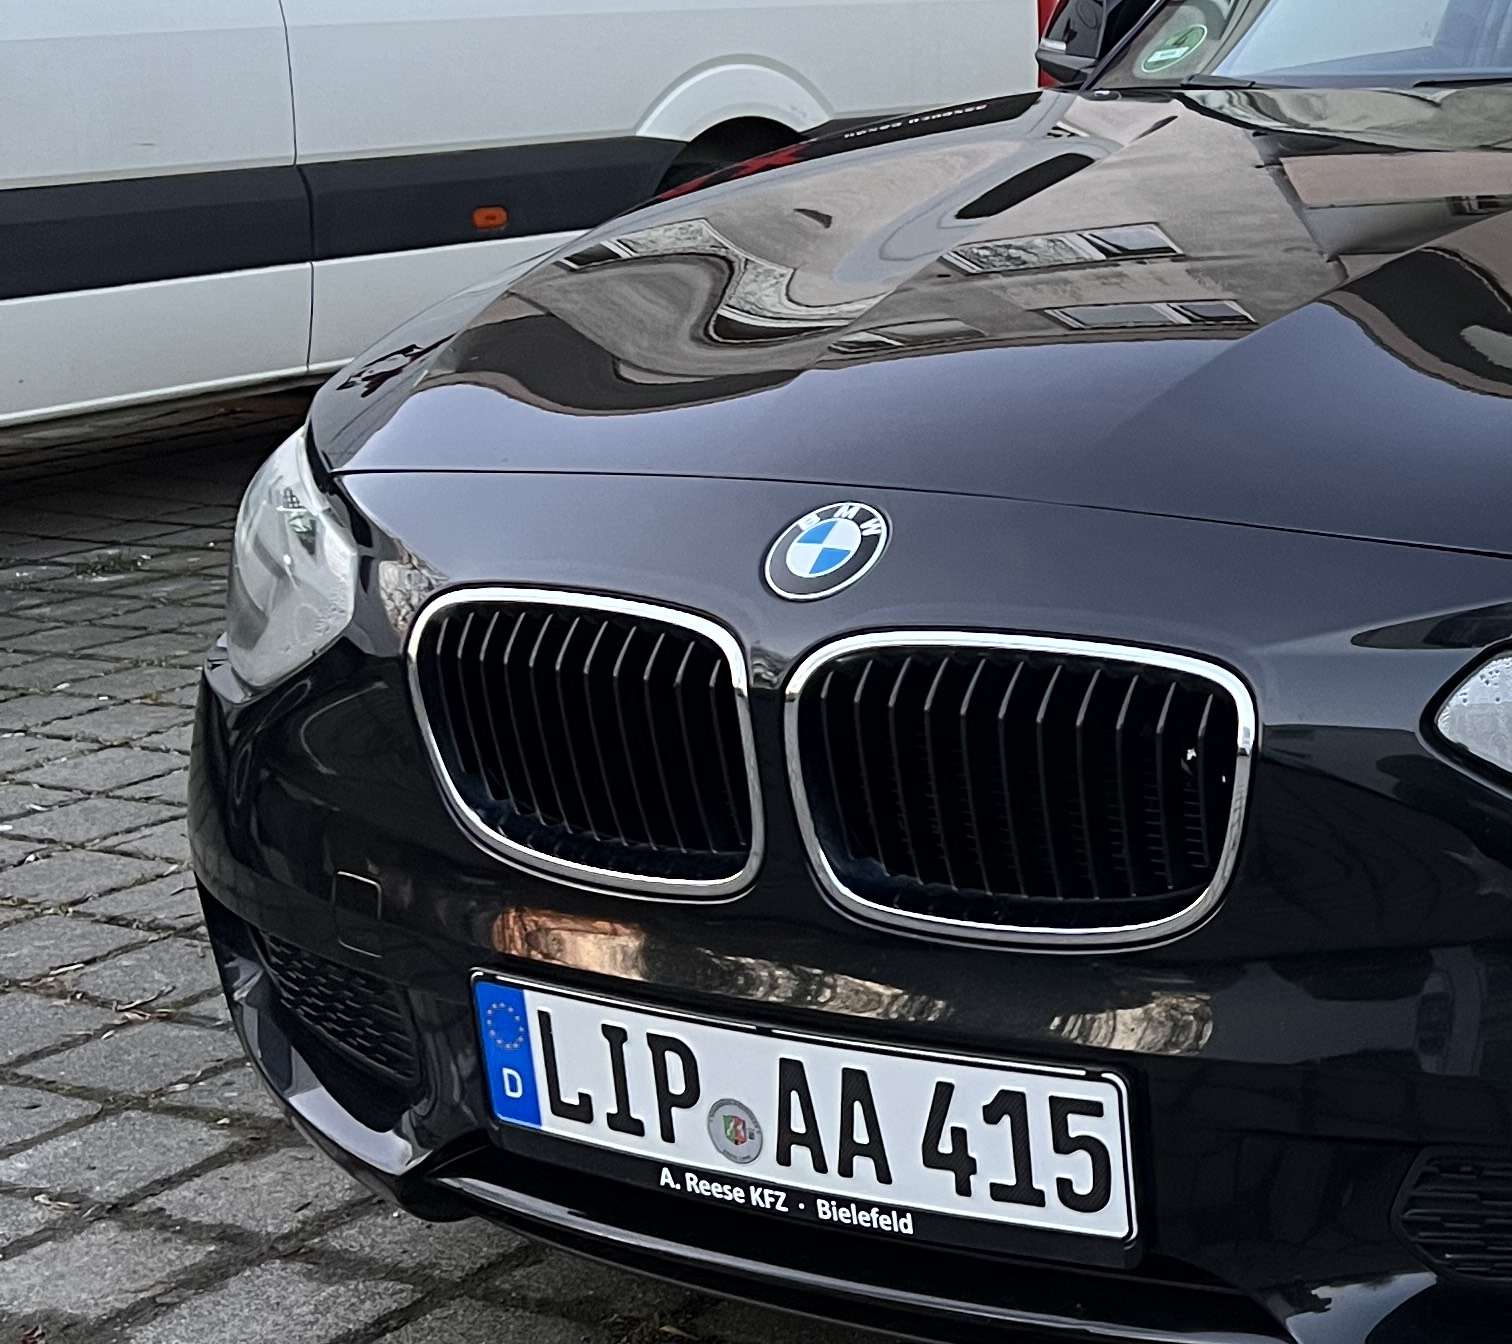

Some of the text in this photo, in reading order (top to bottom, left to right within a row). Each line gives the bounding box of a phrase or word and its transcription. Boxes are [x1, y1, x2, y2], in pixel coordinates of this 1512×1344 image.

[798, 505, 882, 536] BMW
[502, 1068, 523, 1098] D
[536, 1009, 1112, 1215] LIP AA 415
[660, 1167, 914, 1235] A. Reese KFZ Bielefeld
